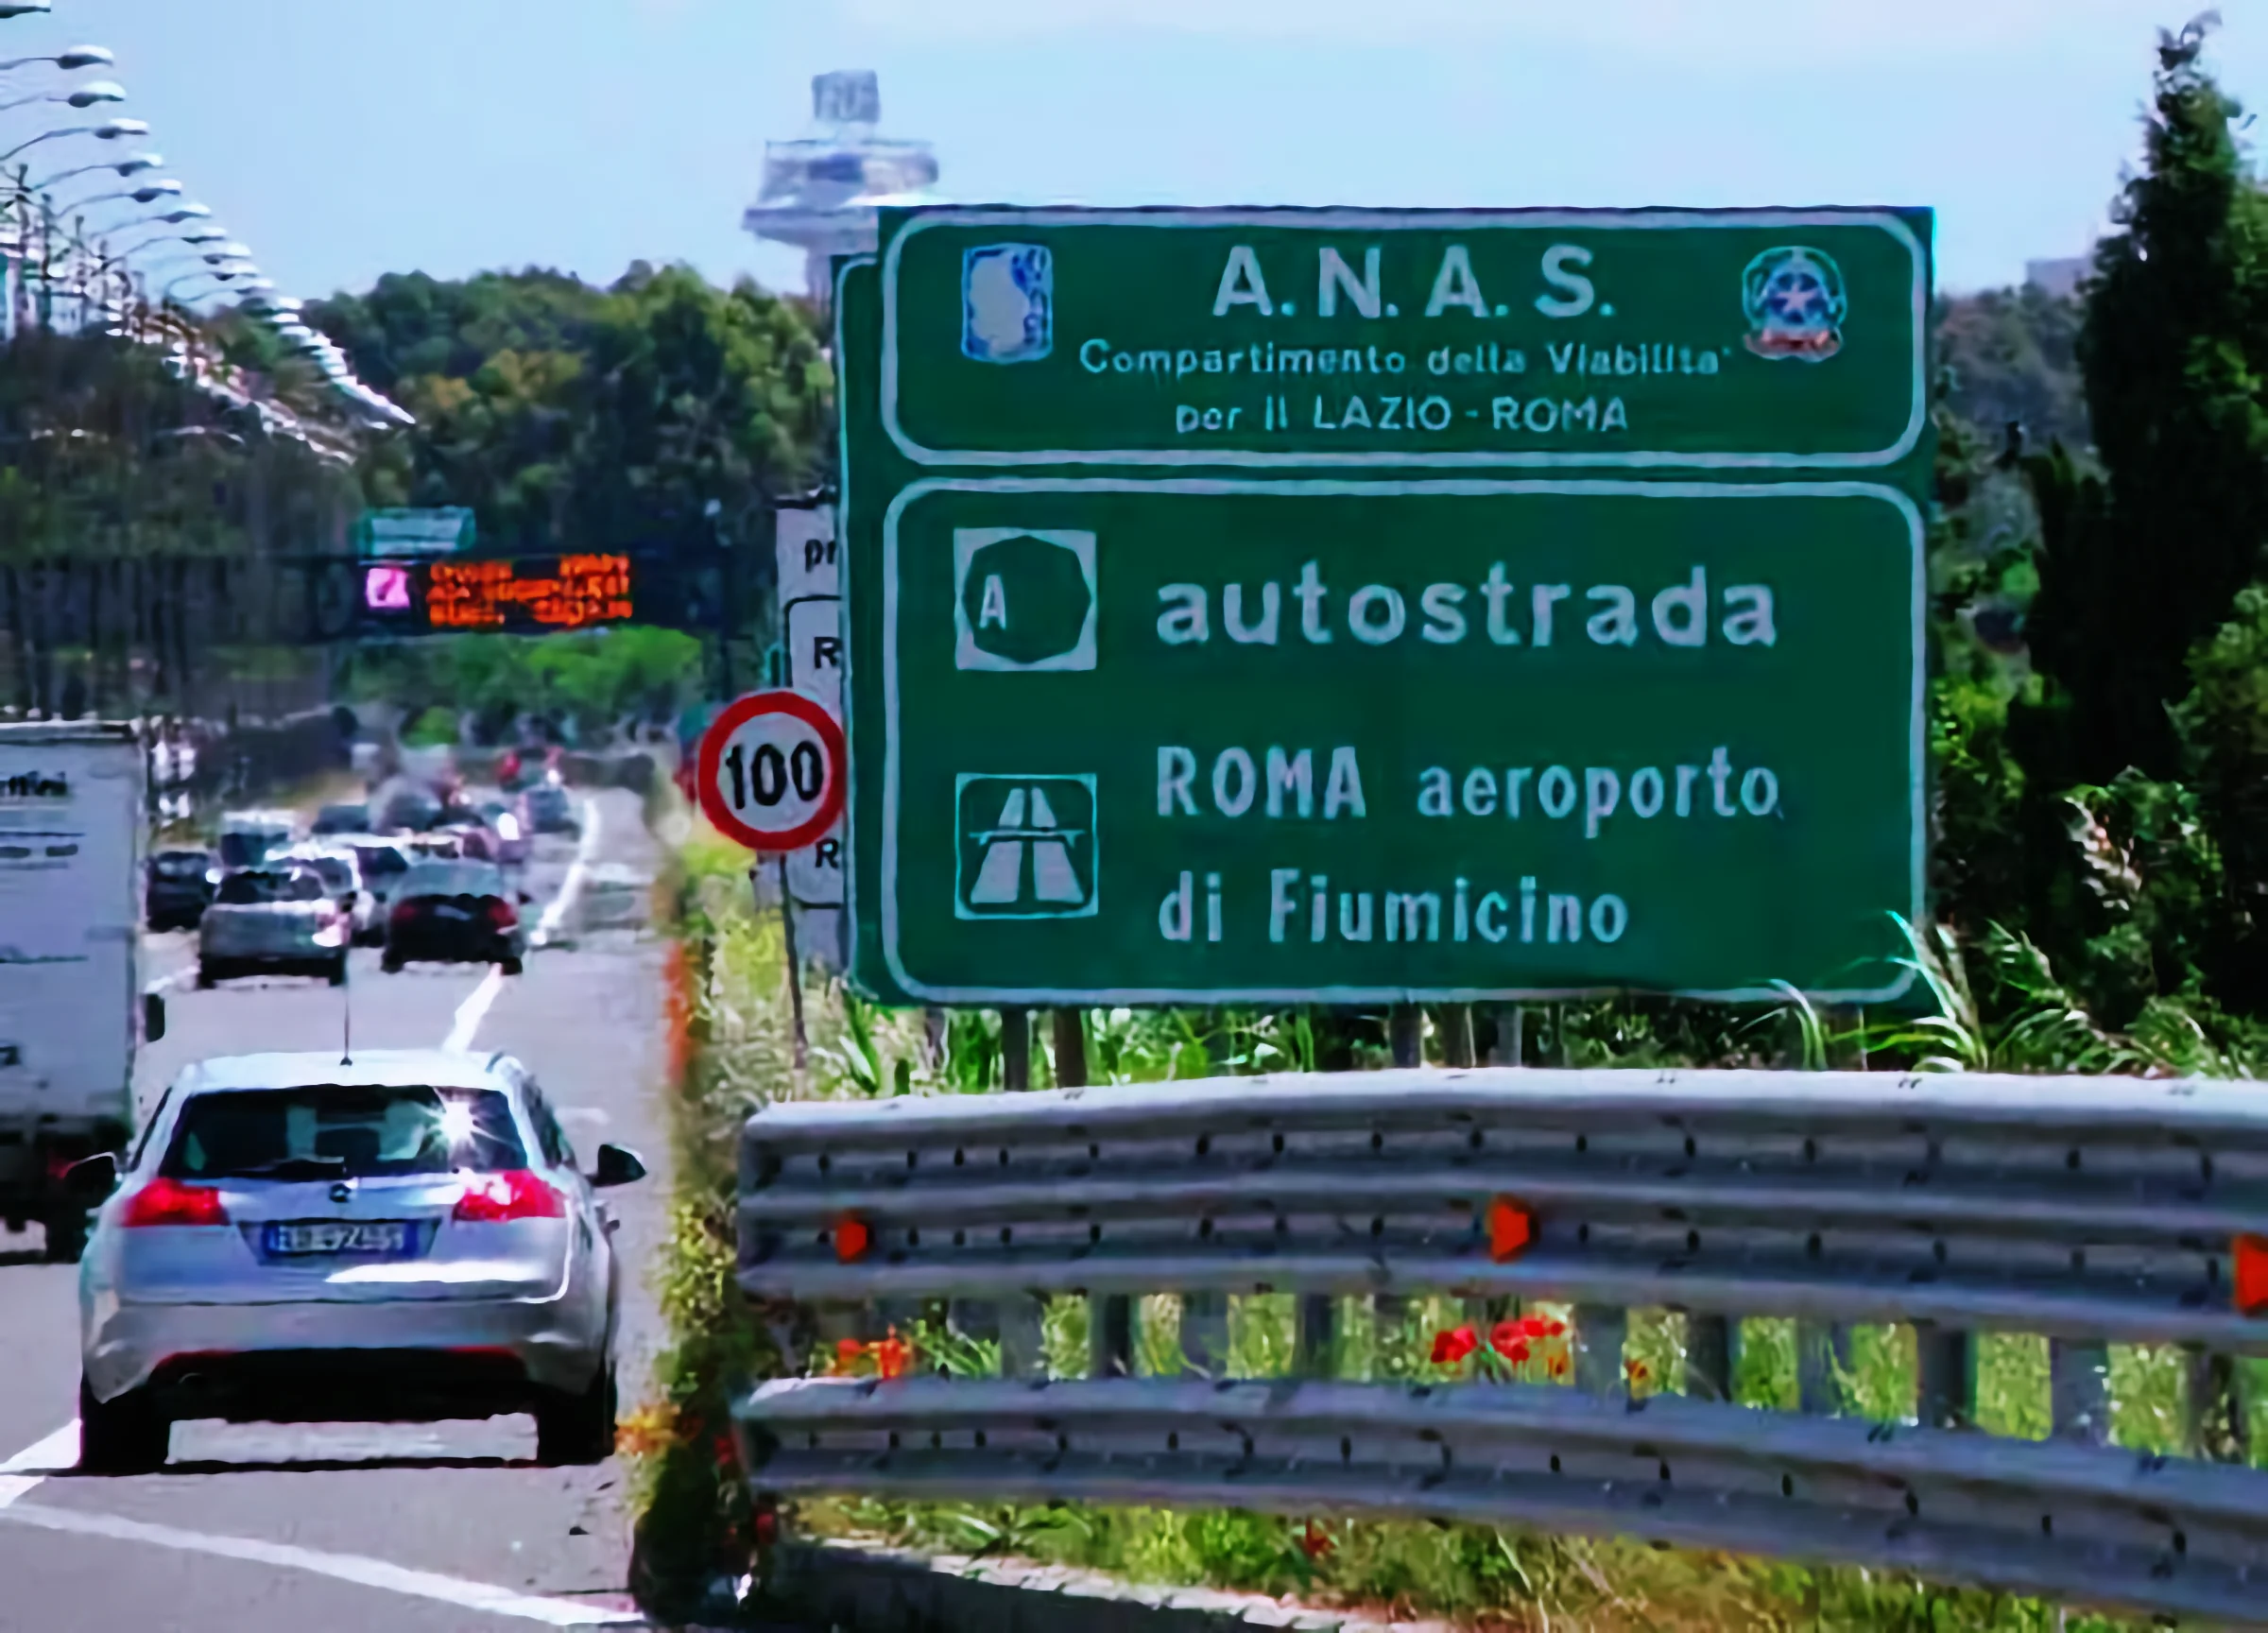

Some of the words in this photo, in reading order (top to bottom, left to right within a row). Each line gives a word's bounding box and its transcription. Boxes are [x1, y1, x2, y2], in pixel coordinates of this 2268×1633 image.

[1079, 338, 1405, 380] Compartimento
[1427, 342, 1526, 375] della
[1314, 394, 1452, 431] LAZIO
[1491, 395, 1627, 433] ROMA
[978, 574, 1007, 630] A
[1156, 560, 1777, 647] autostrada
[724, 742, 825, 811] 100
[1157, 745, 1366, 820] ROMA
[1417, 745, 1780, 839] aeroporto
[1158, 869, 1223, 942] di
[1268, 868, 1628, 944] Fiumicino
